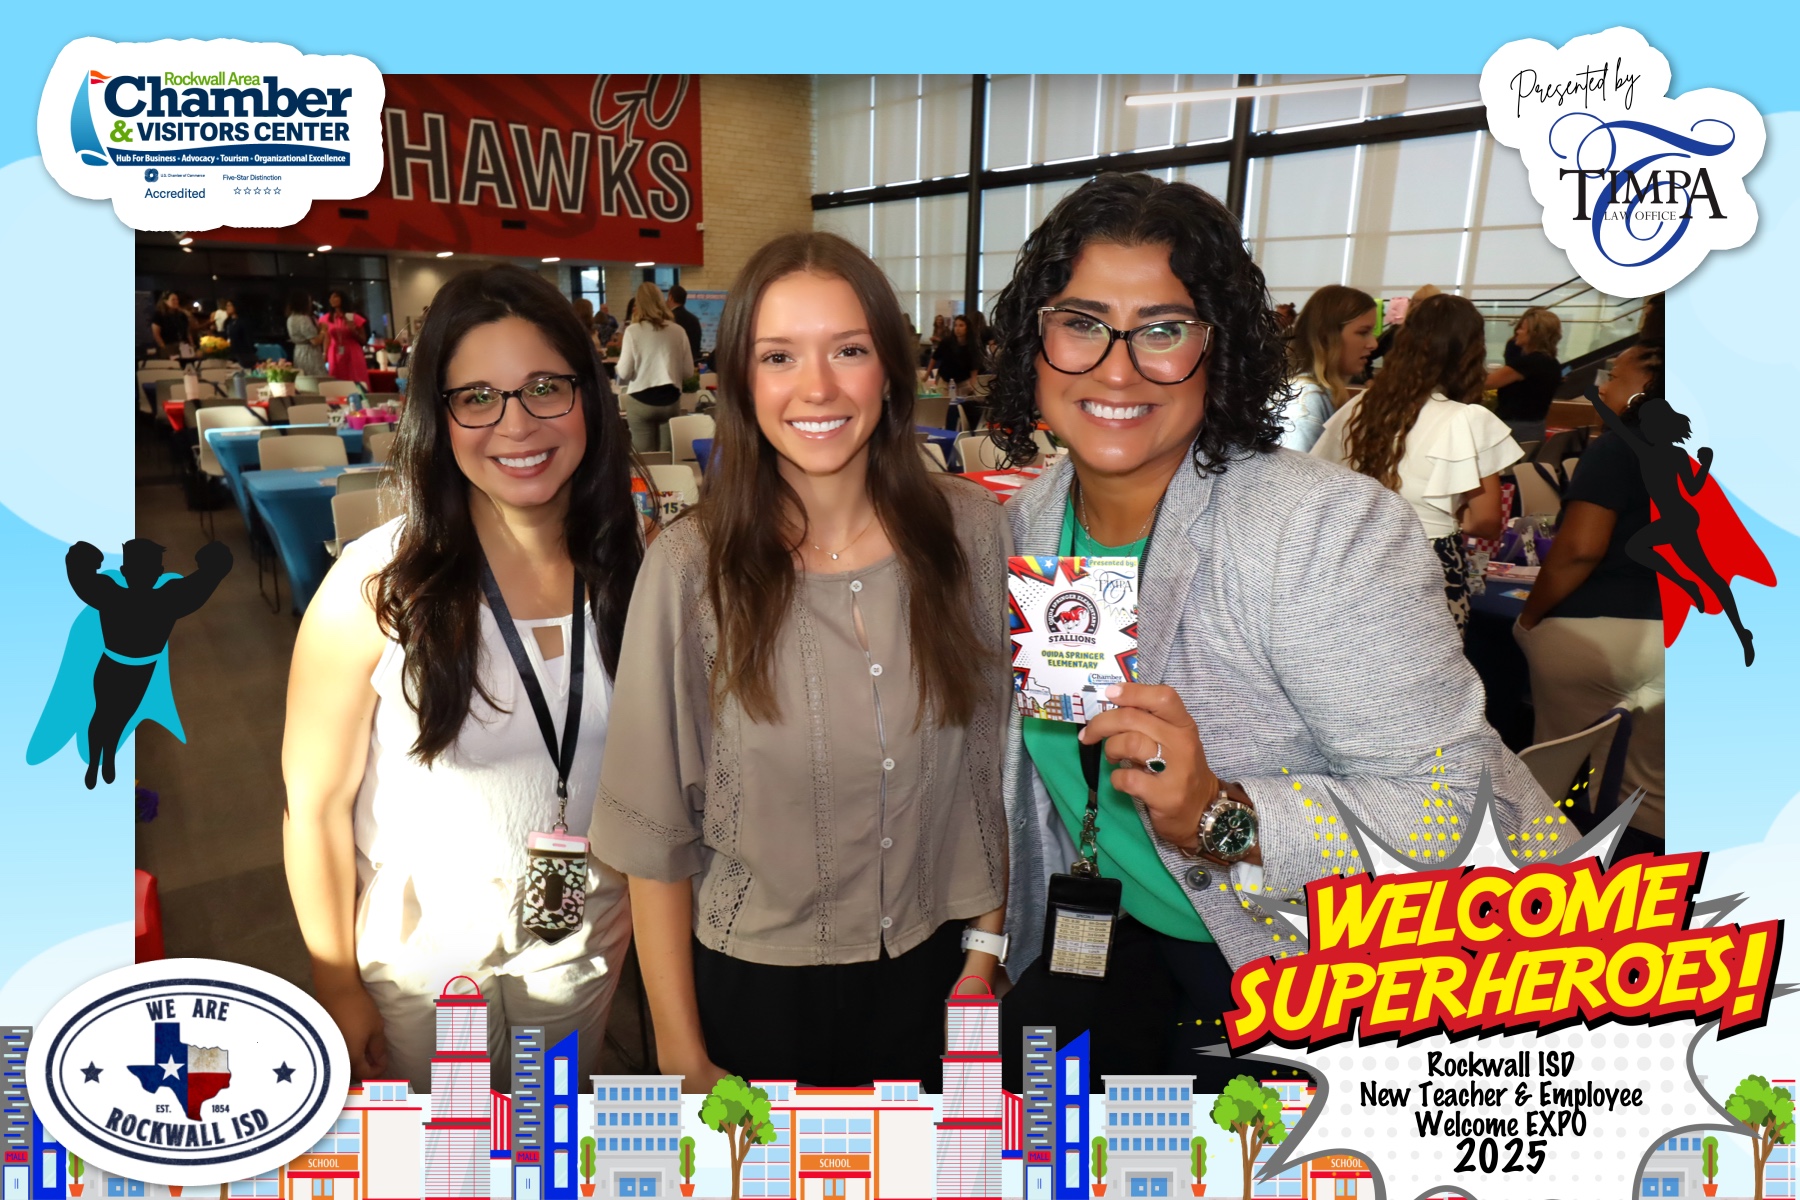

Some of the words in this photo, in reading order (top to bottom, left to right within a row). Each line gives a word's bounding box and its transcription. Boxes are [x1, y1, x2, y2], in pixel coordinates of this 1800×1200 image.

[590, 74, 689, 146] GO
[384, 107, 690, 222] HAWKS
[662, 502, 679, 514] 15
[1048, 634, 1096, 644] STALLIONS
[1041, 650, 1064, 659] OUIDA
[1065, 651, 1105, 660] SPRINGER
[1047, 659, 1099, 669] ELEMENTARY
